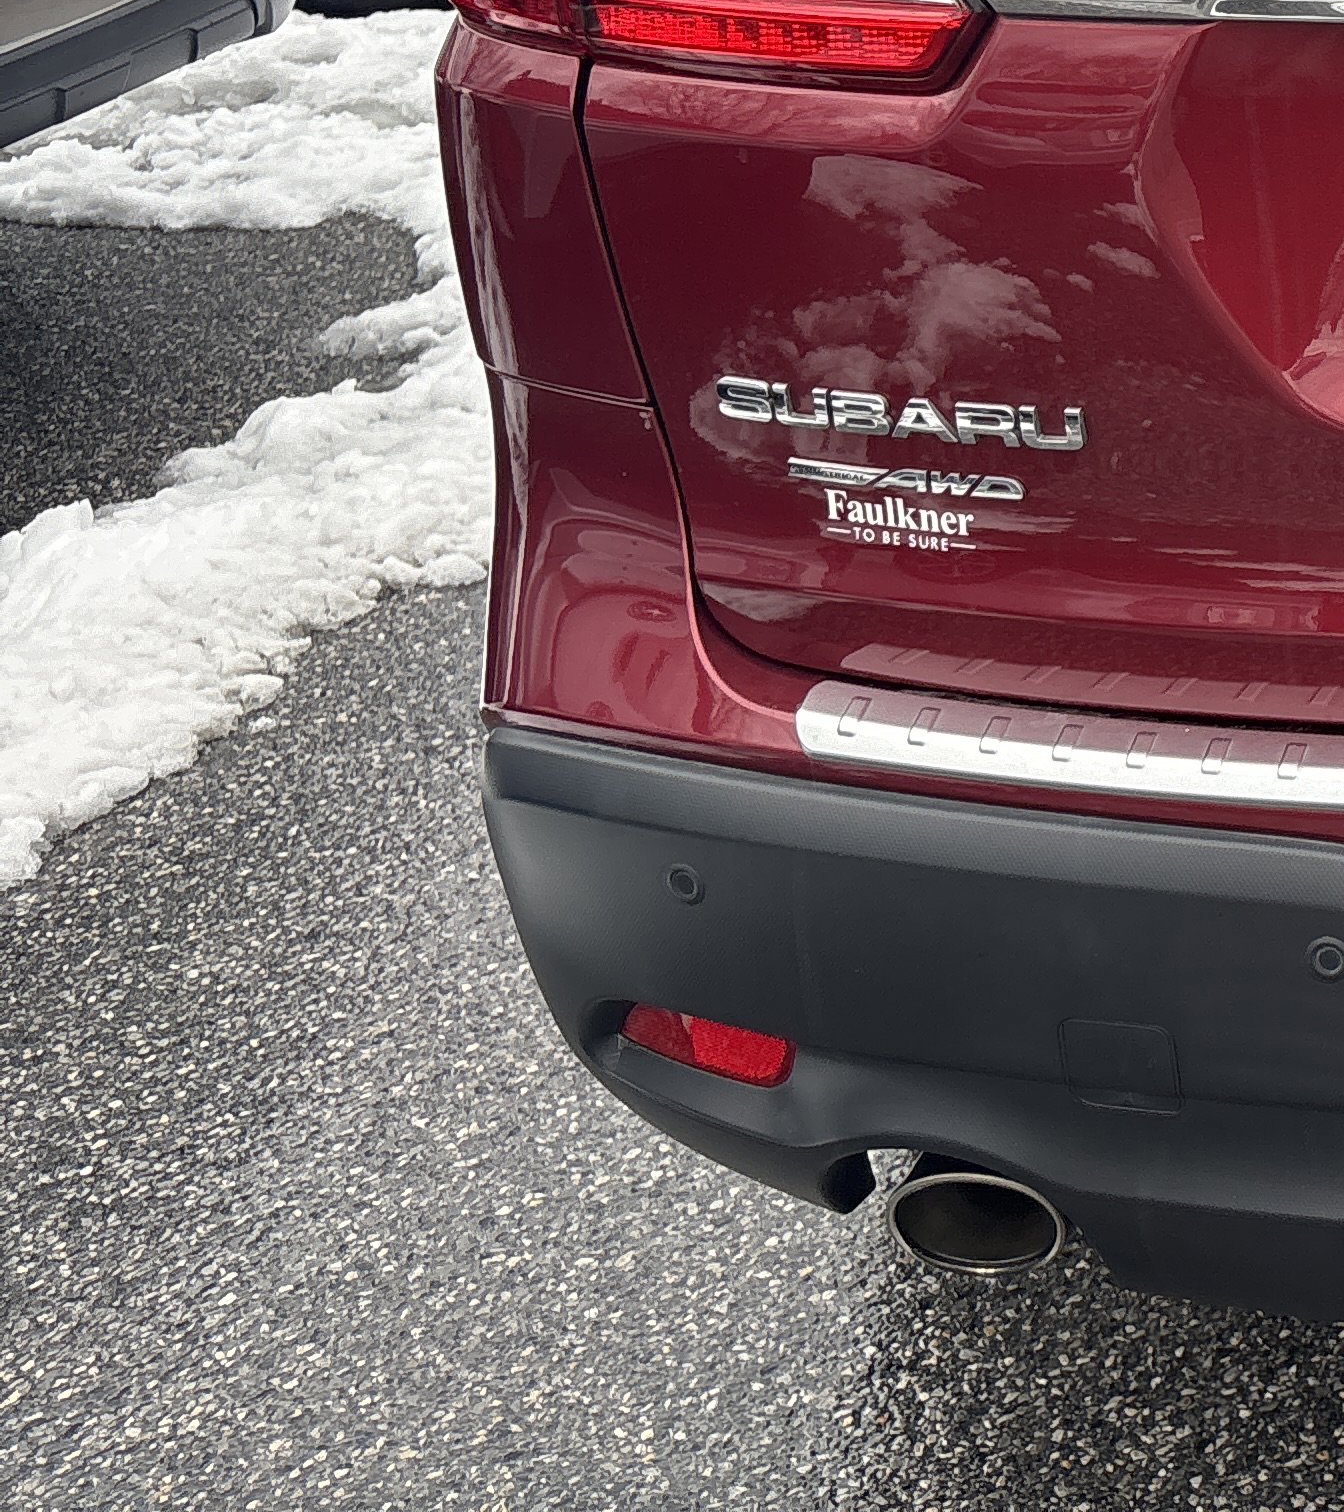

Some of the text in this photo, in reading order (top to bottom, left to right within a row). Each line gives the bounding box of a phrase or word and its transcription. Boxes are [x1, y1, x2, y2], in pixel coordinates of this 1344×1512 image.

[716, 374, 1088, 451] SUBARU
[873, 468, 1027, 500] AWD
[823, 488, 975, 537] Faulkner
[852, 526, 949, 552] TO BE SURE
